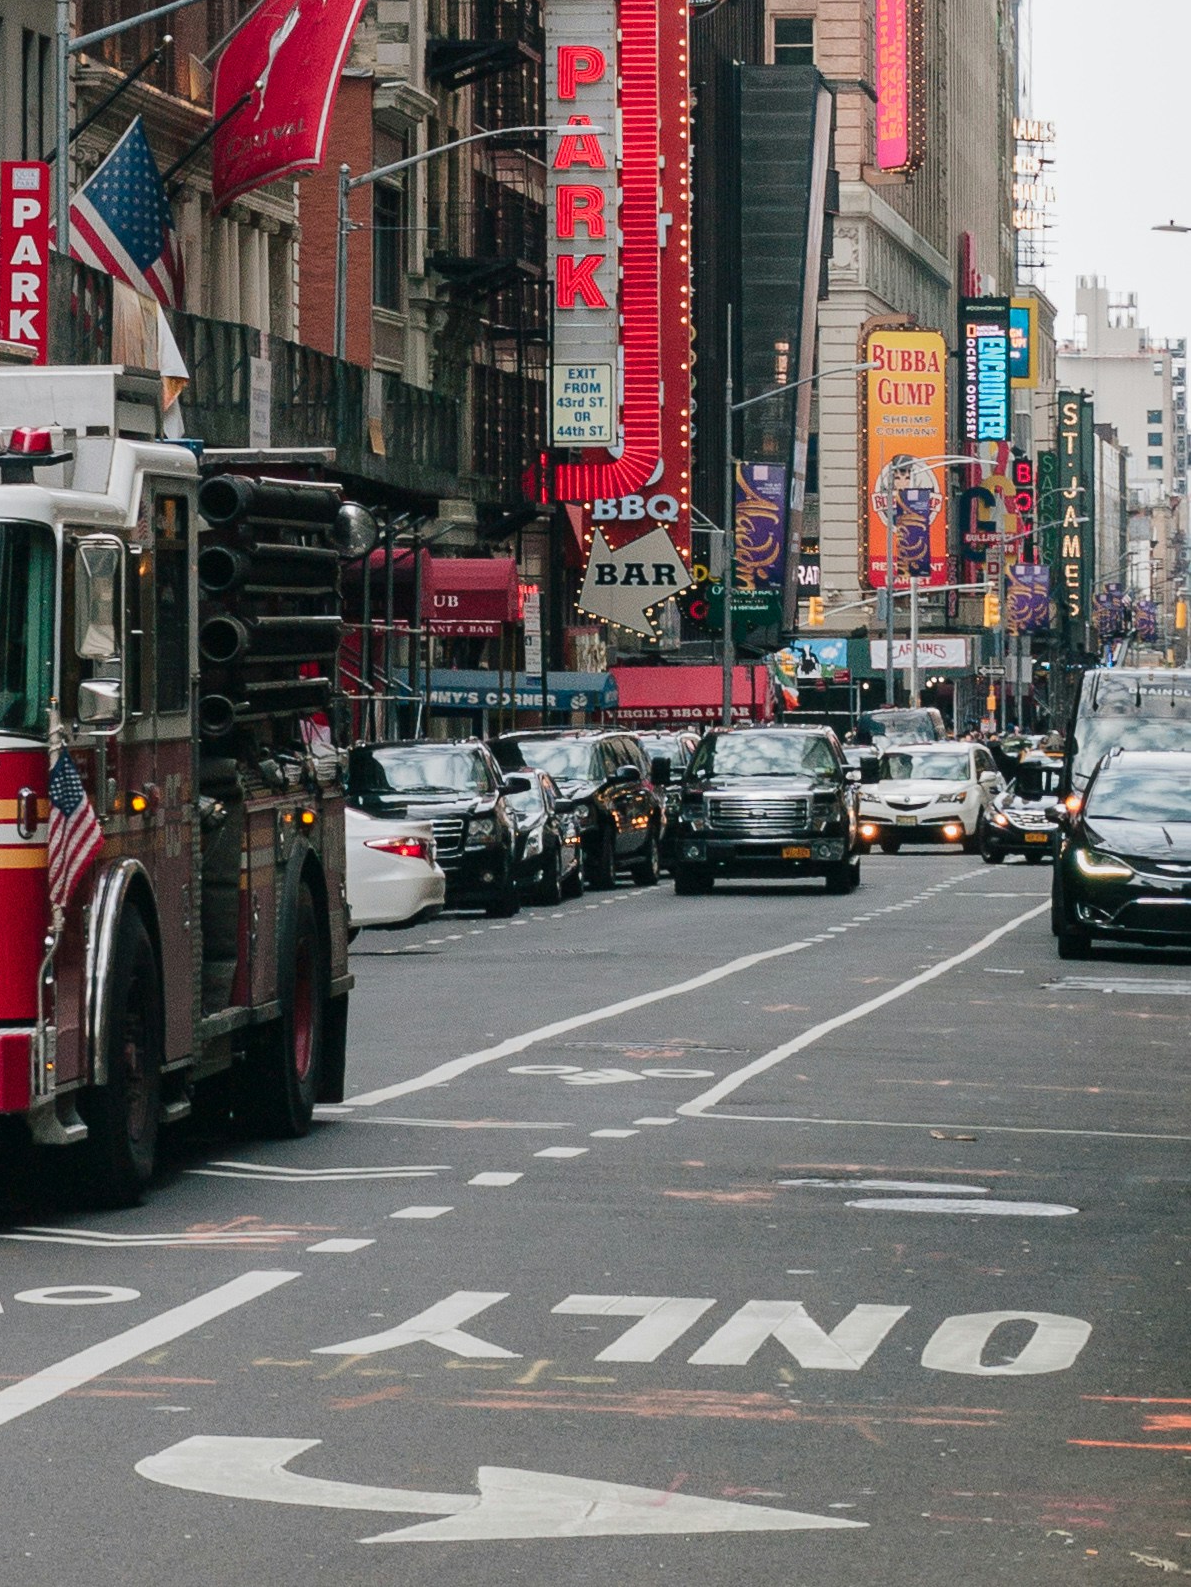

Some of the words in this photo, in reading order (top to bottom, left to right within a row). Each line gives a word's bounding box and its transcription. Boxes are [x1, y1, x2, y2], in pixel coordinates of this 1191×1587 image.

[554, 45, 609, 309] PARK
[10, 198, 42, 340] PARK
[871, 344, 941, 373] BUBBA
[966, 338, 977, 381] OCEAN
[568, 368, 597, 380] EXIT
[564, 382, 601, 393] FROM
[877, 378, 937, 406] GUMP
[978, 337, 1007, 440] ENCOUNTER
[556, 397, 585, 408] 43rd
[589, 396, 608, 408] ST.
[574, 411, 591, 423] OR
[882, 414, 932, 424] SHRIMP
[966, 386, 977, 440] ODYSSEY
[556, 425, 585, 437] 44th
[589, 425, 608, 437] ST.
[876, 427, 938, 436] COMPANY
[591, 494, 679, 522] BBQ
[595, 563, 678, 586] BAR
[469, 625, 495, 633] BAR
[485, 692, 557, 707] CORNER
[672, 707, 703, 717] BBQ
[705, 708, 715, 717] &
[310, 1290, 1093, 1377] ONLY
